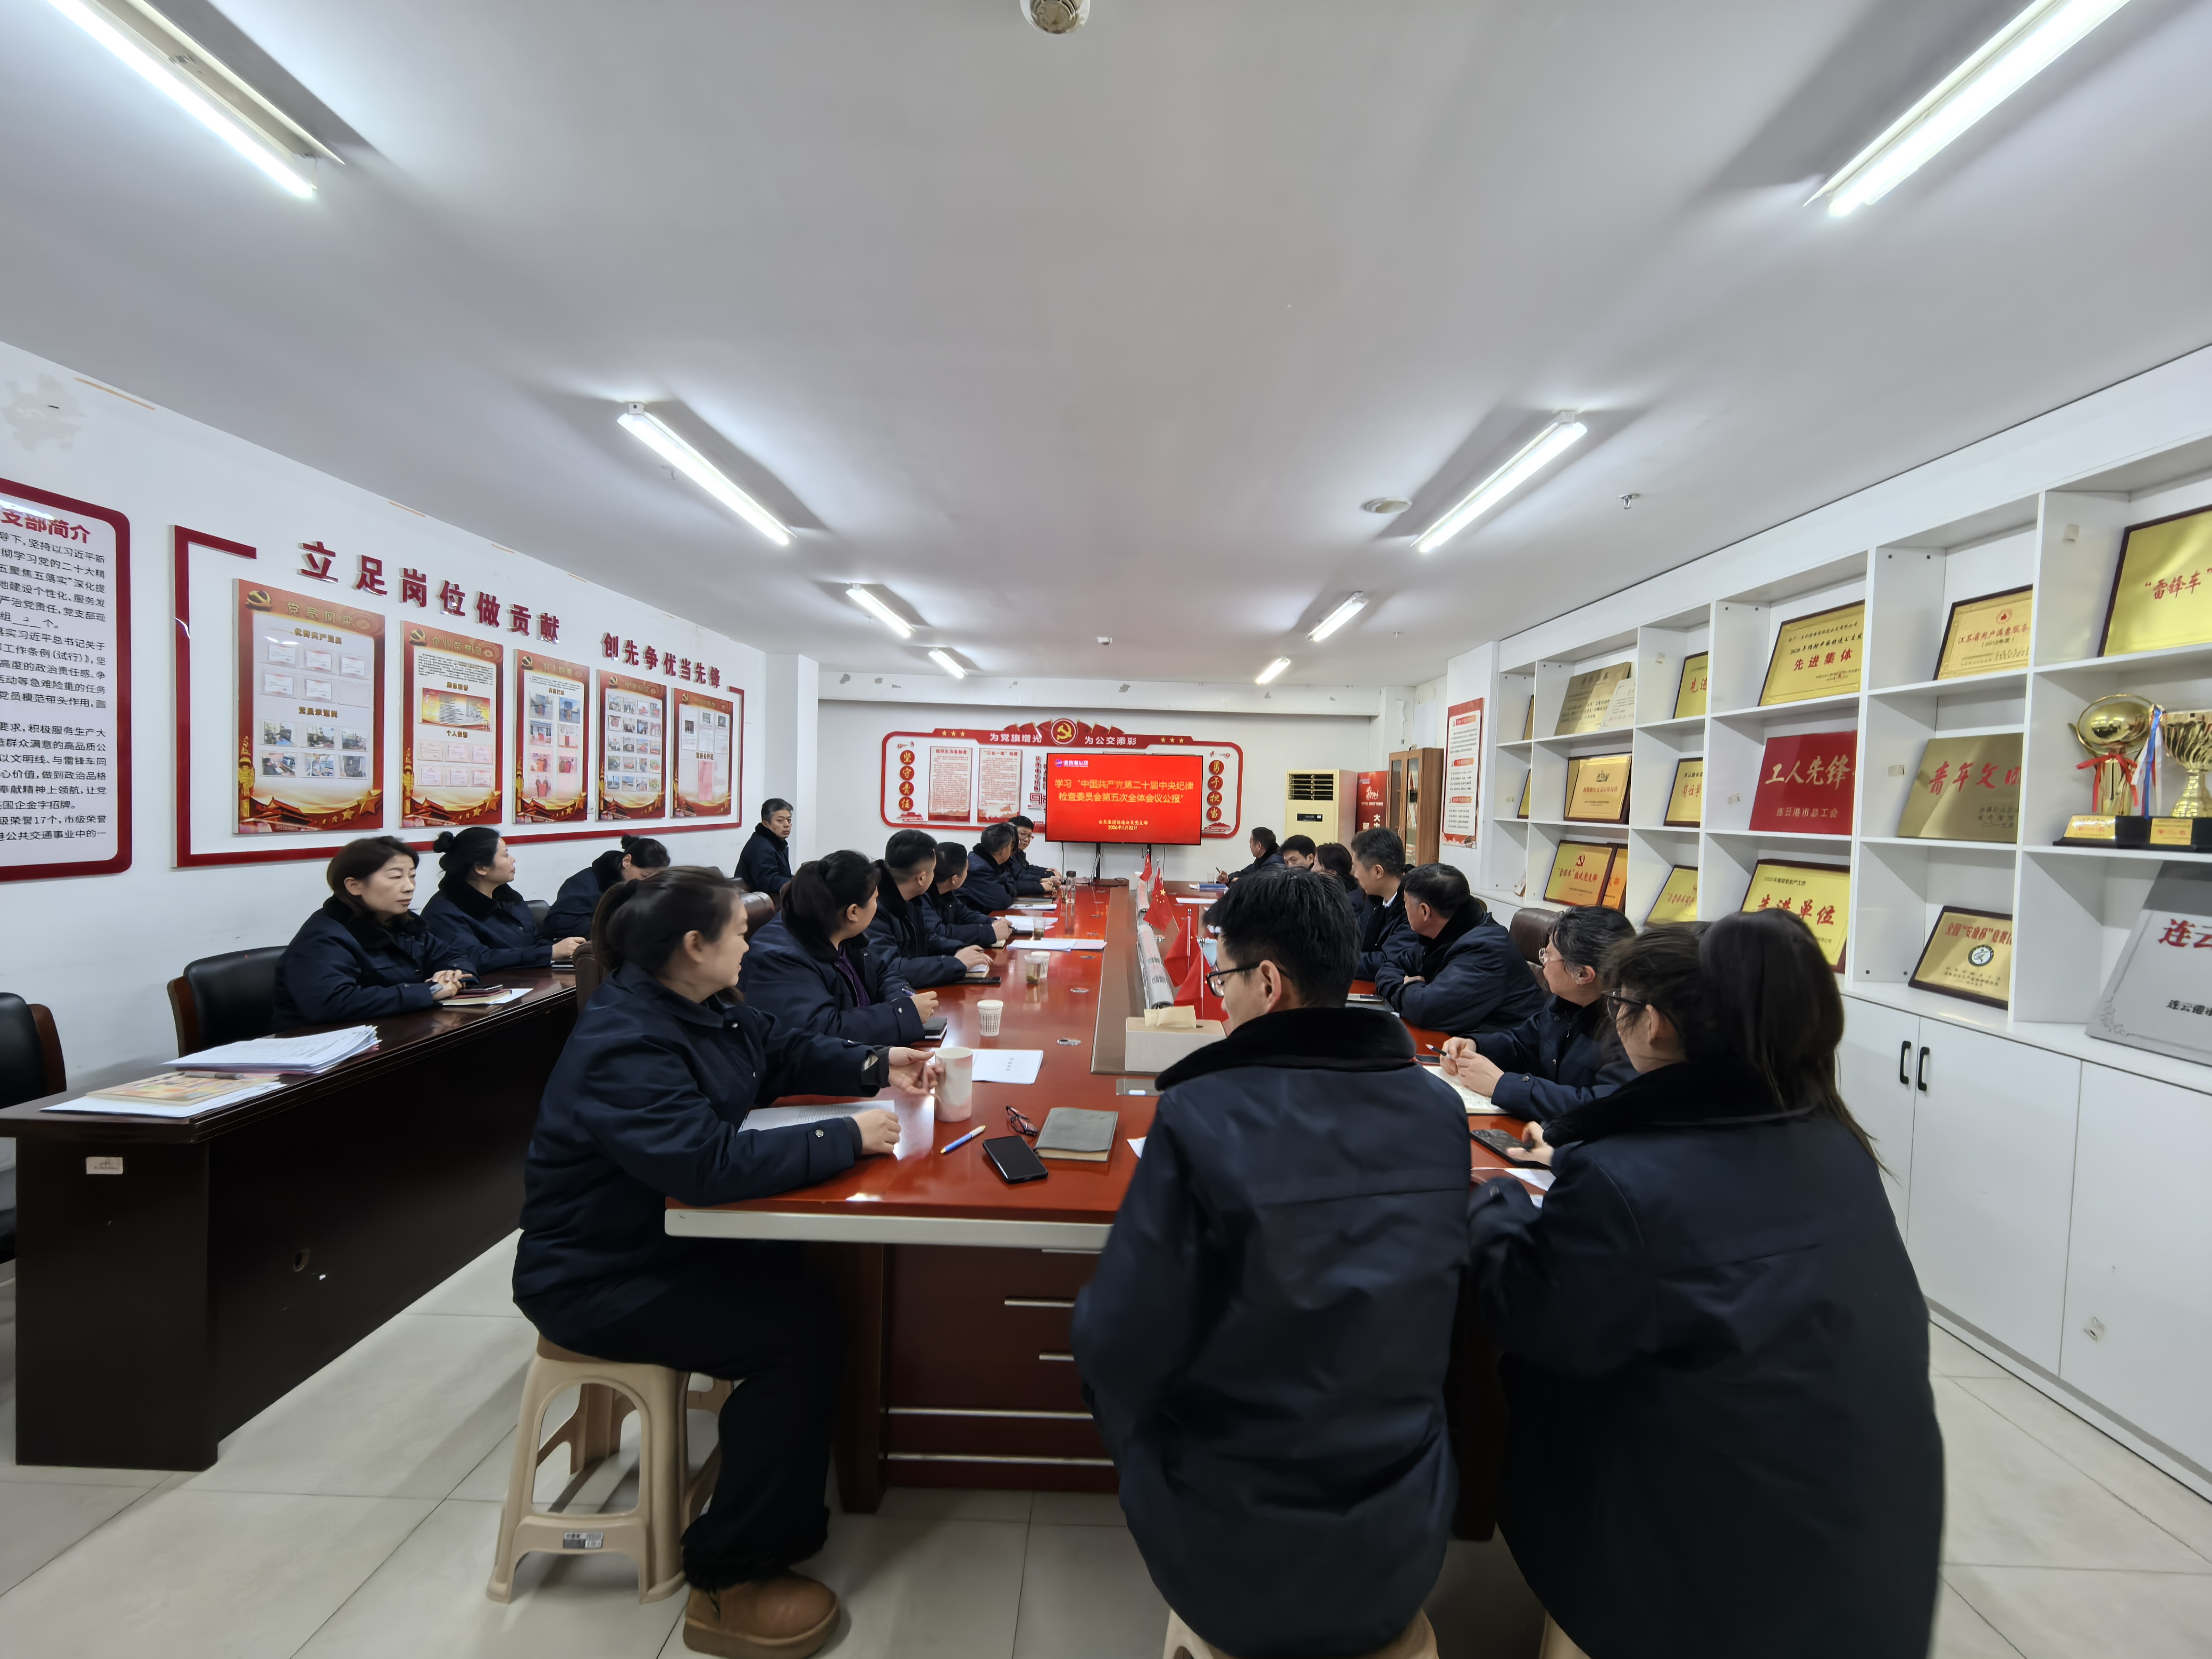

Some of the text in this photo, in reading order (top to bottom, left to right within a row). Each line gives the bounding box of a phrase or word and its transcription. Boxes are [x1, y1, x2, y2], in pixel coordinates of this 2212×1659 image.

[1, 510, 91, 543] 支部简介
[297, 541, 559, 644] 立足岗位做贡献
[2144, 567, 2212, 600] “雷锋车”
[601, 632, 720, 689] 创先争优当先锋
[1793, 648, 1853, 672] 先进集体
[990, 733, 1042, 743] 为党旗增光
[1085, 736, 1136, 745] 为公交添彩
[1765, 754, 1850, 791] 工人先锋
[0, 801, 76, 810] 国企金字招牌。
[1059, 792, 1184, 804] 检查委员会第五次全体会议公报”
